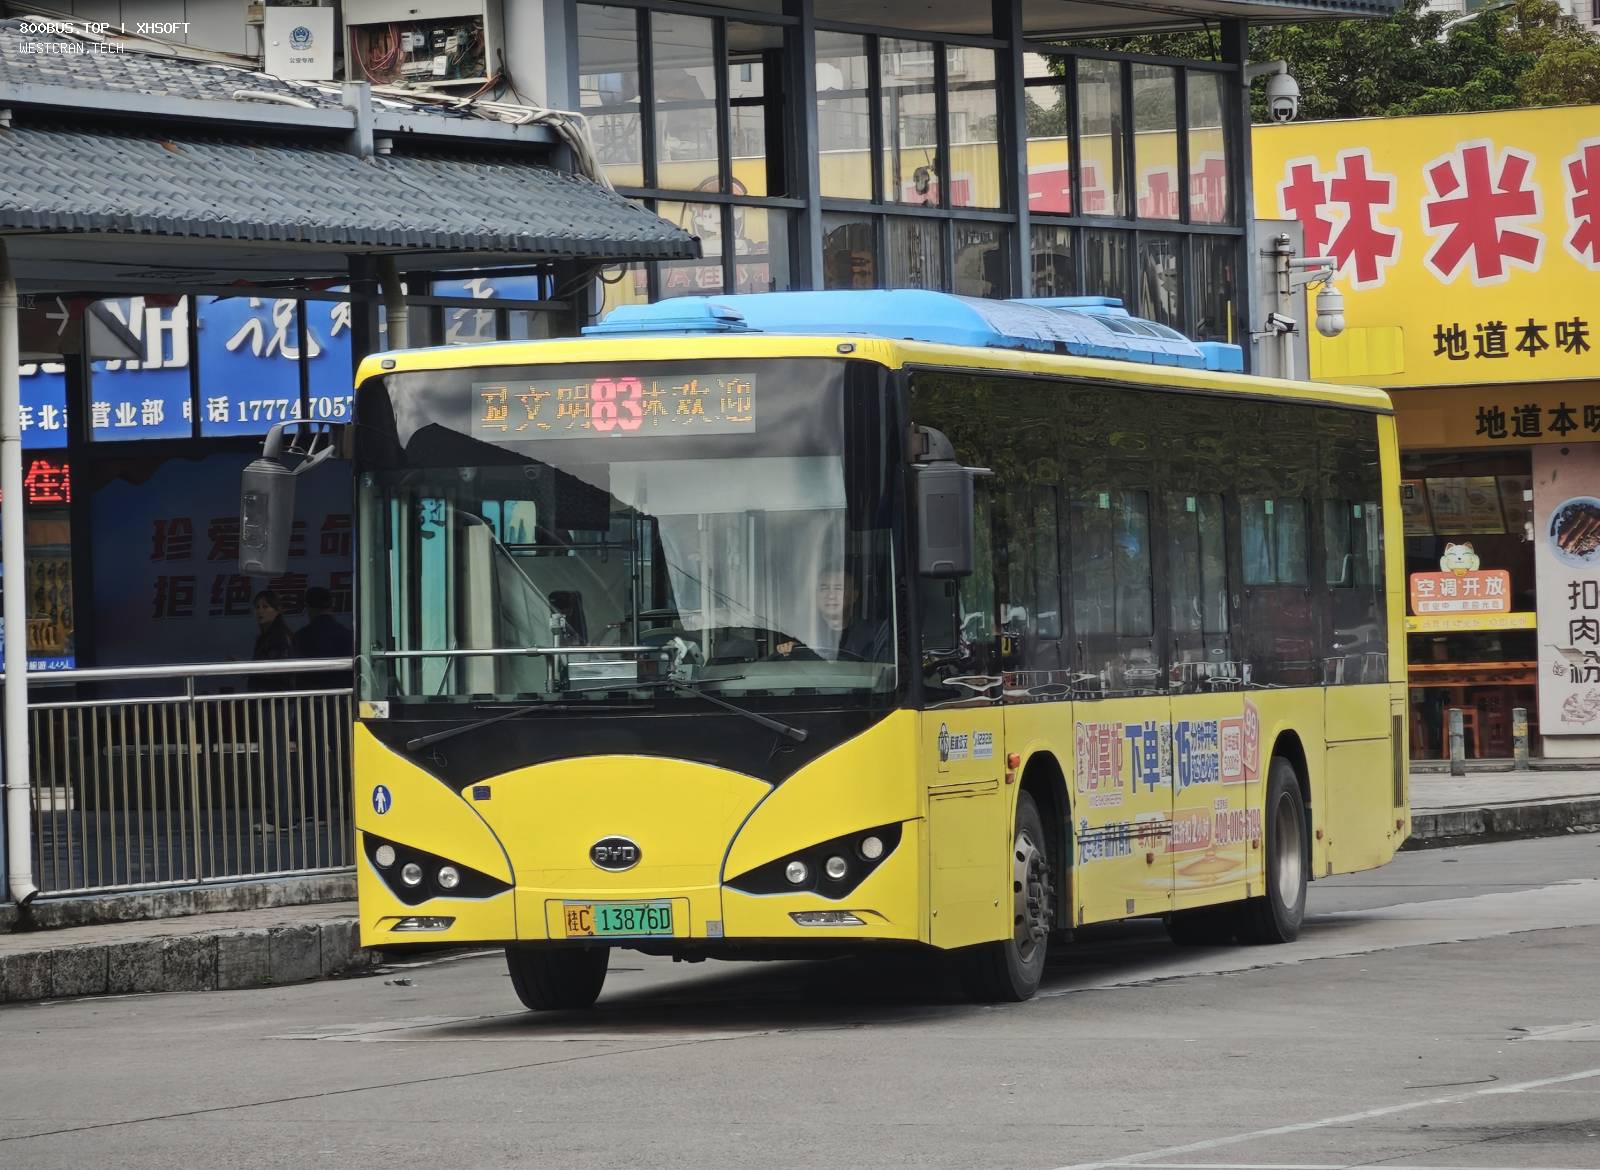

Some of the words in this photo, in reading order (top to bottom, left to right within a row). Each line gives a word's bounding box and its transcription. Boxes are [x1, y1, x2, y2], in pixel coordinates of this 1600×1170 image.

[1433, 316, 1590, 361] 地道本味
[589, 375, 643, 433] 83
[150, 513, 353, 561] 珍爱命
[1416, 576, 1505, 598] 空调开放
[1174, 721, 1192, 787] 15
[595, 845, 635, 862] BYD
[601, 907, 671, 932] 13876D
